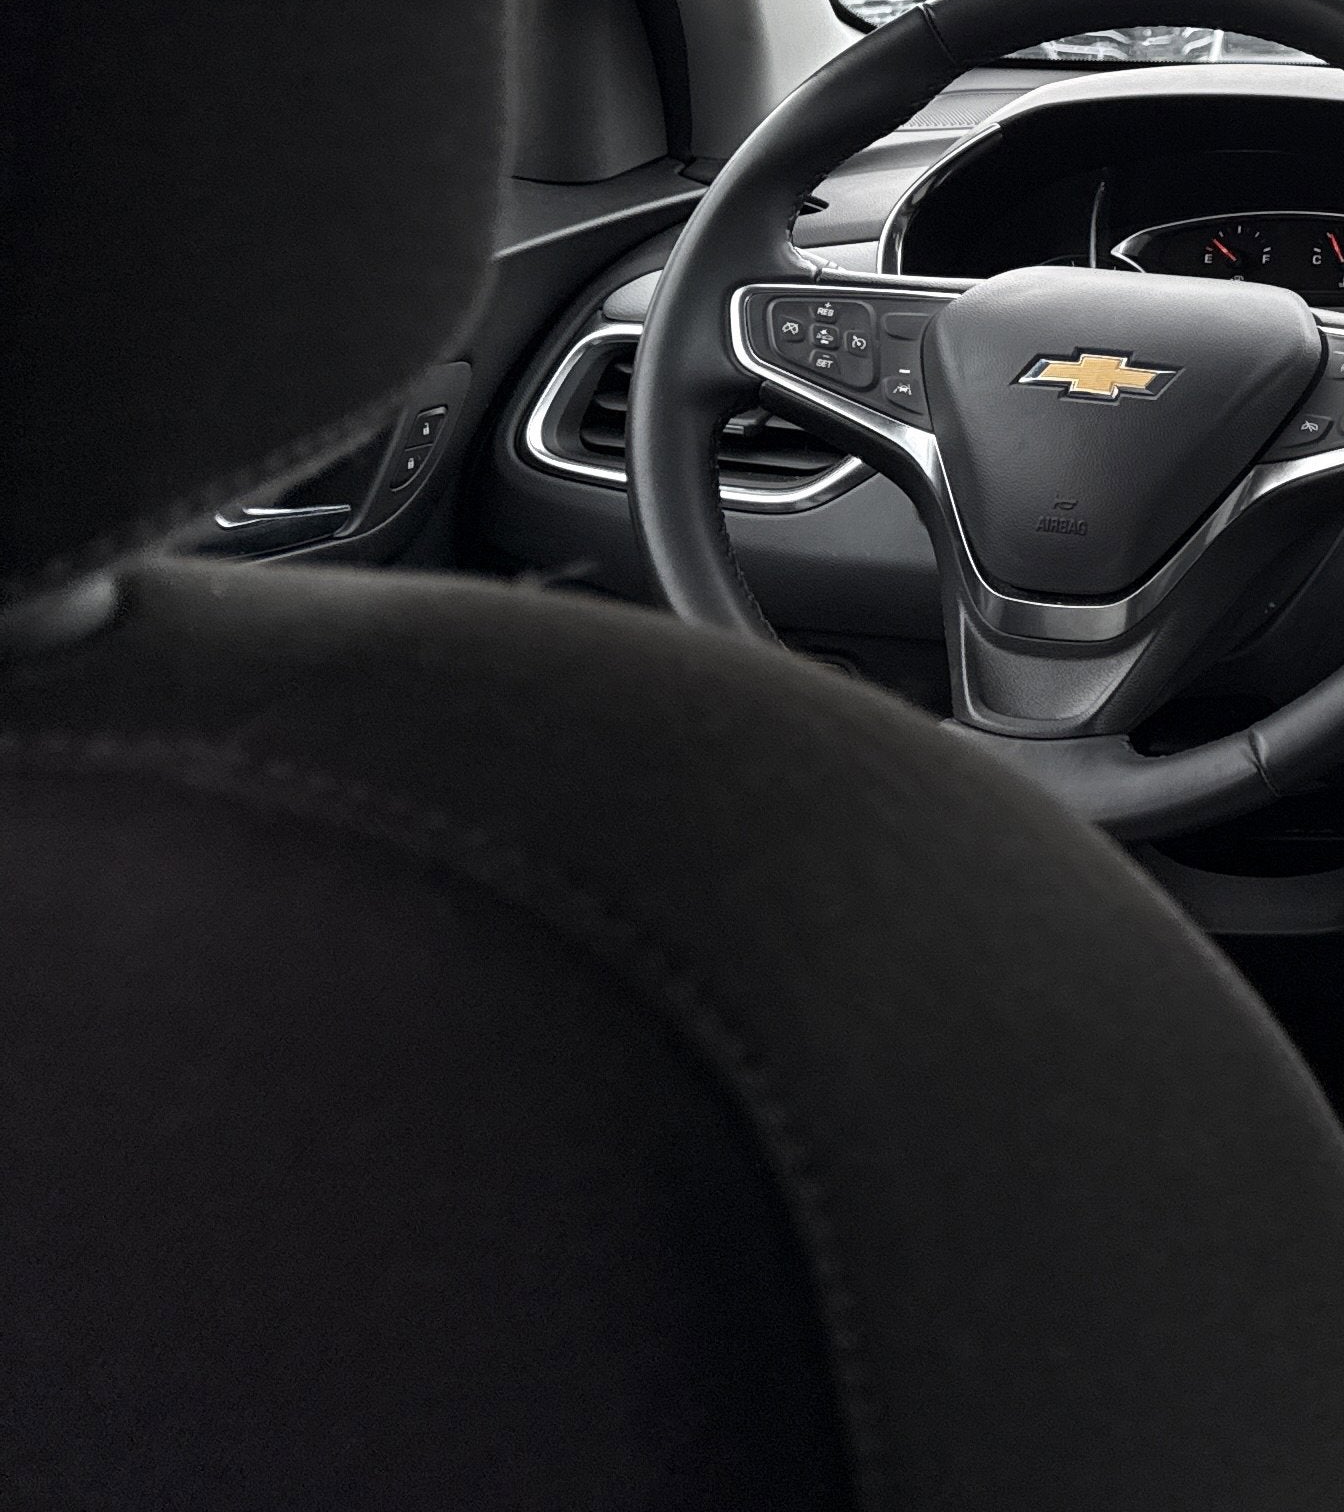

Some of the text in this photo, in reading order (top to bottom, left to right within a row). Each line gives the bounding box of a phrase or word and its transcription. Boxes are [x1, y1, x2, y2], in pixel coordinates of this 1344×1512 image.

[1204, 254, 1213, 265] E
[1262, 254, 1271, 265] F
[1312, 255, 1322, 265] C
[815, 358, 834, 369] SET
[1036, 517, 1088, 536] AIRBAG
